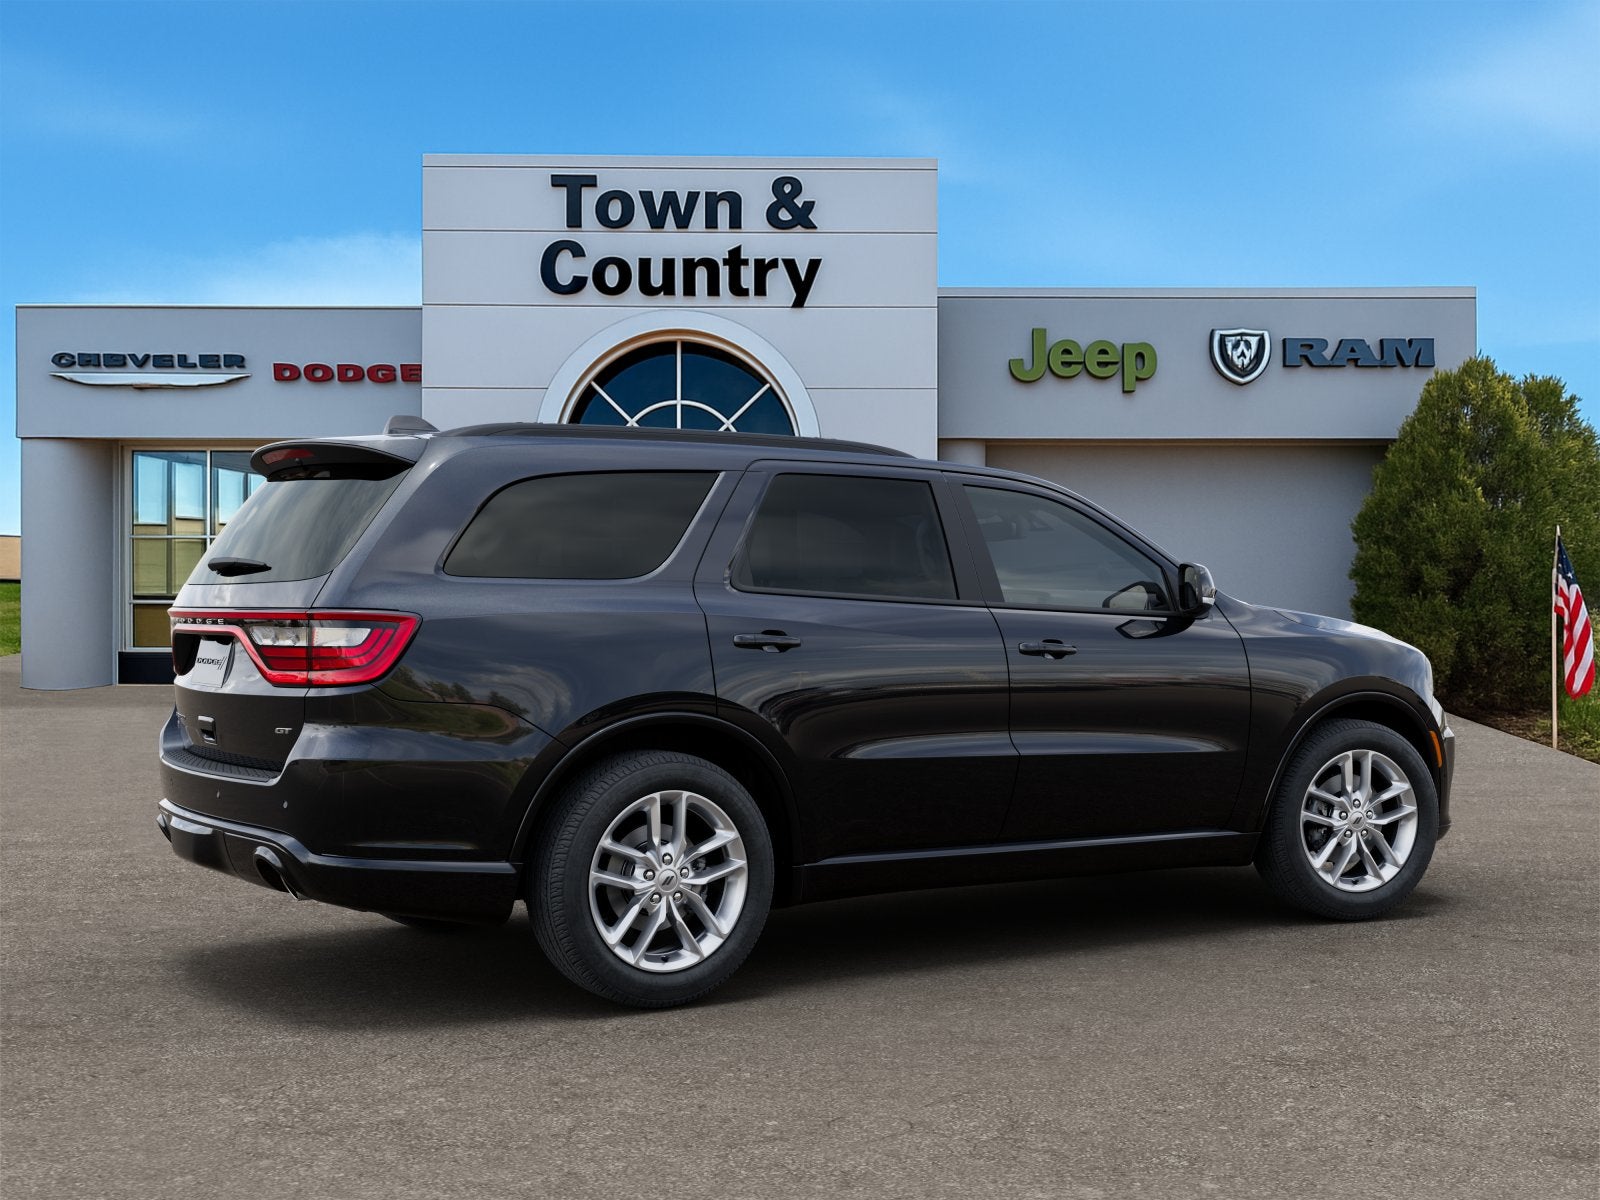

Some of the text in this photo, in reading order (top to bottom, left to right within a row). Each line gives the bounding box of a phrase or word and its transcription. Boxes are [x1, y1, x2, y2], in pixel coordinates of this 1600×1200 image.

[551, 174, 818, 230] Town &
[540, 239, 822, 308] Country
[273, 362, 422, 383] DODGE
[1009, 328, 1157, 393] Jeep
[1282, 337, 1435, 368] RAM
[274, 727, 293, 735] GT
